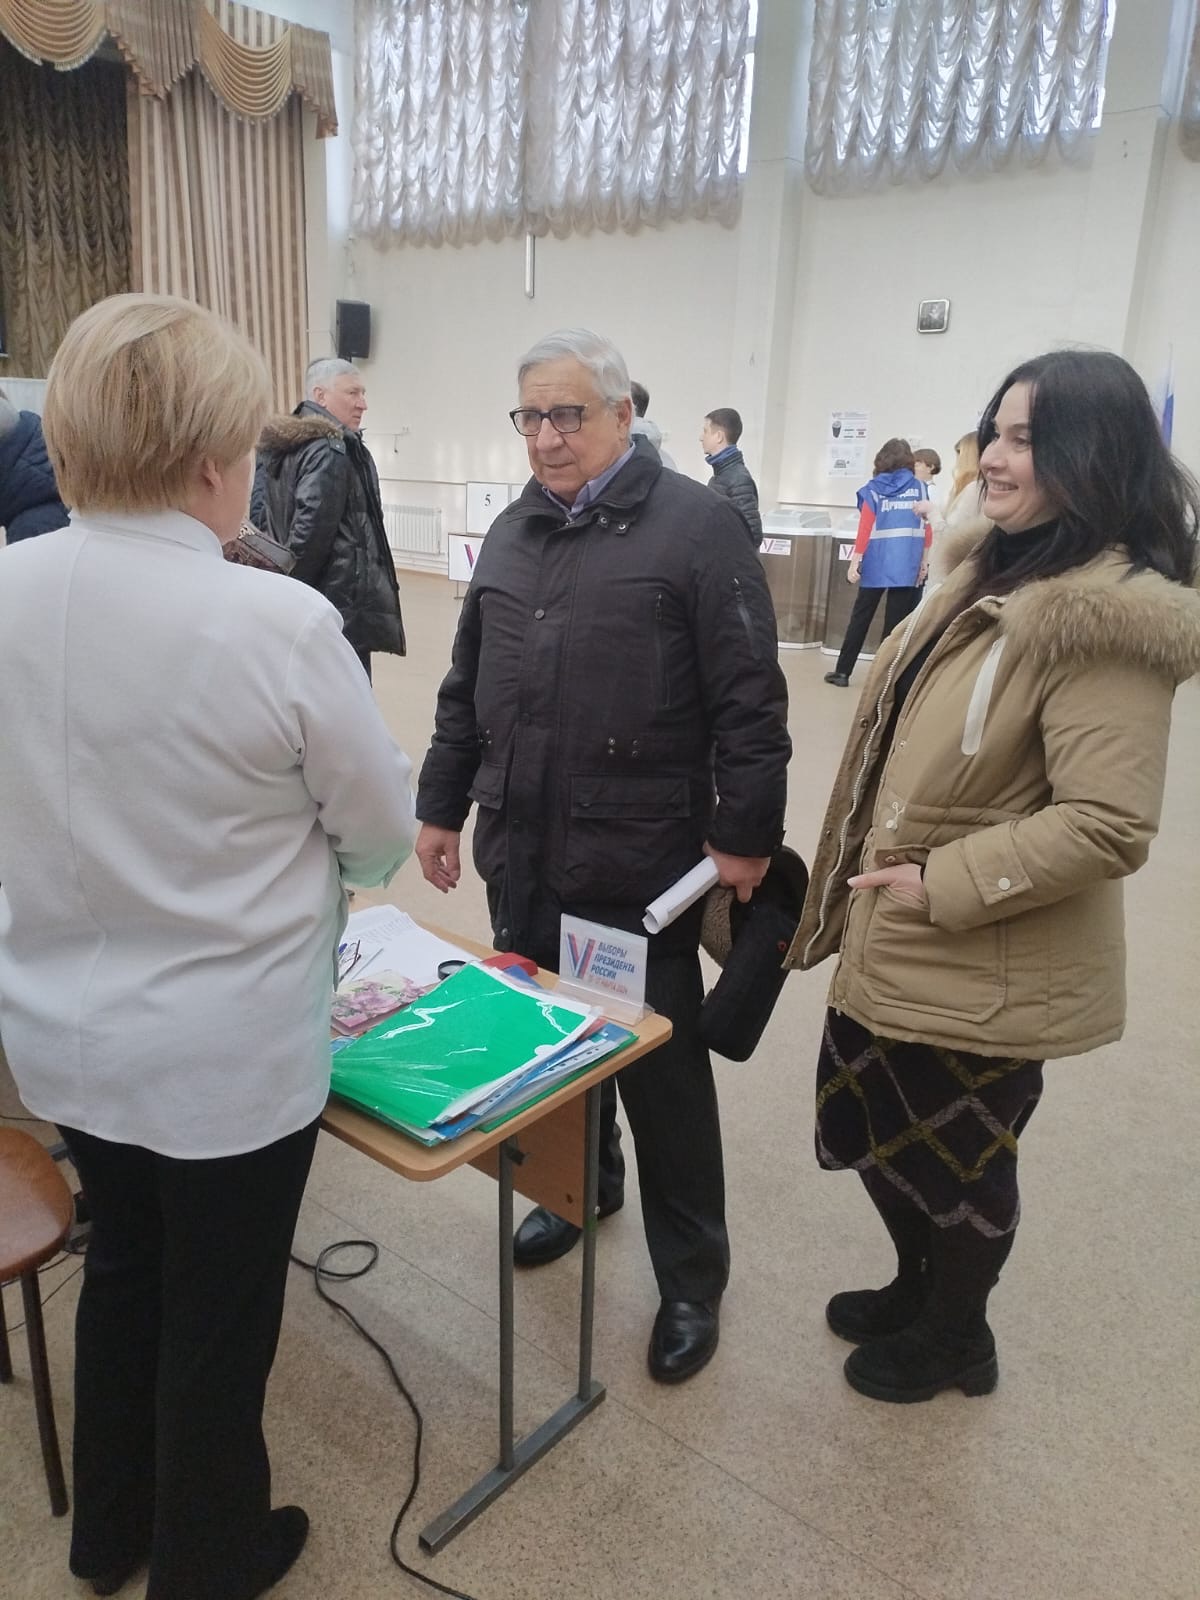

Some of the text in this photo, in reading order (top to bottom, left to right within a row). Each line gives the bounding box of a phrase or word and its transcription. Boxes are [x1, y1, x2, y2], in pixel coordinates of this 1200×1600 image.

[484, 493, 491, 507] 5
[598, 942, 628, 958] ВЫБОРЫ
[594, 953, 635, 974] ПРЕЗИДЕНТА
[590, 965, 617, 980] РОССИИ
